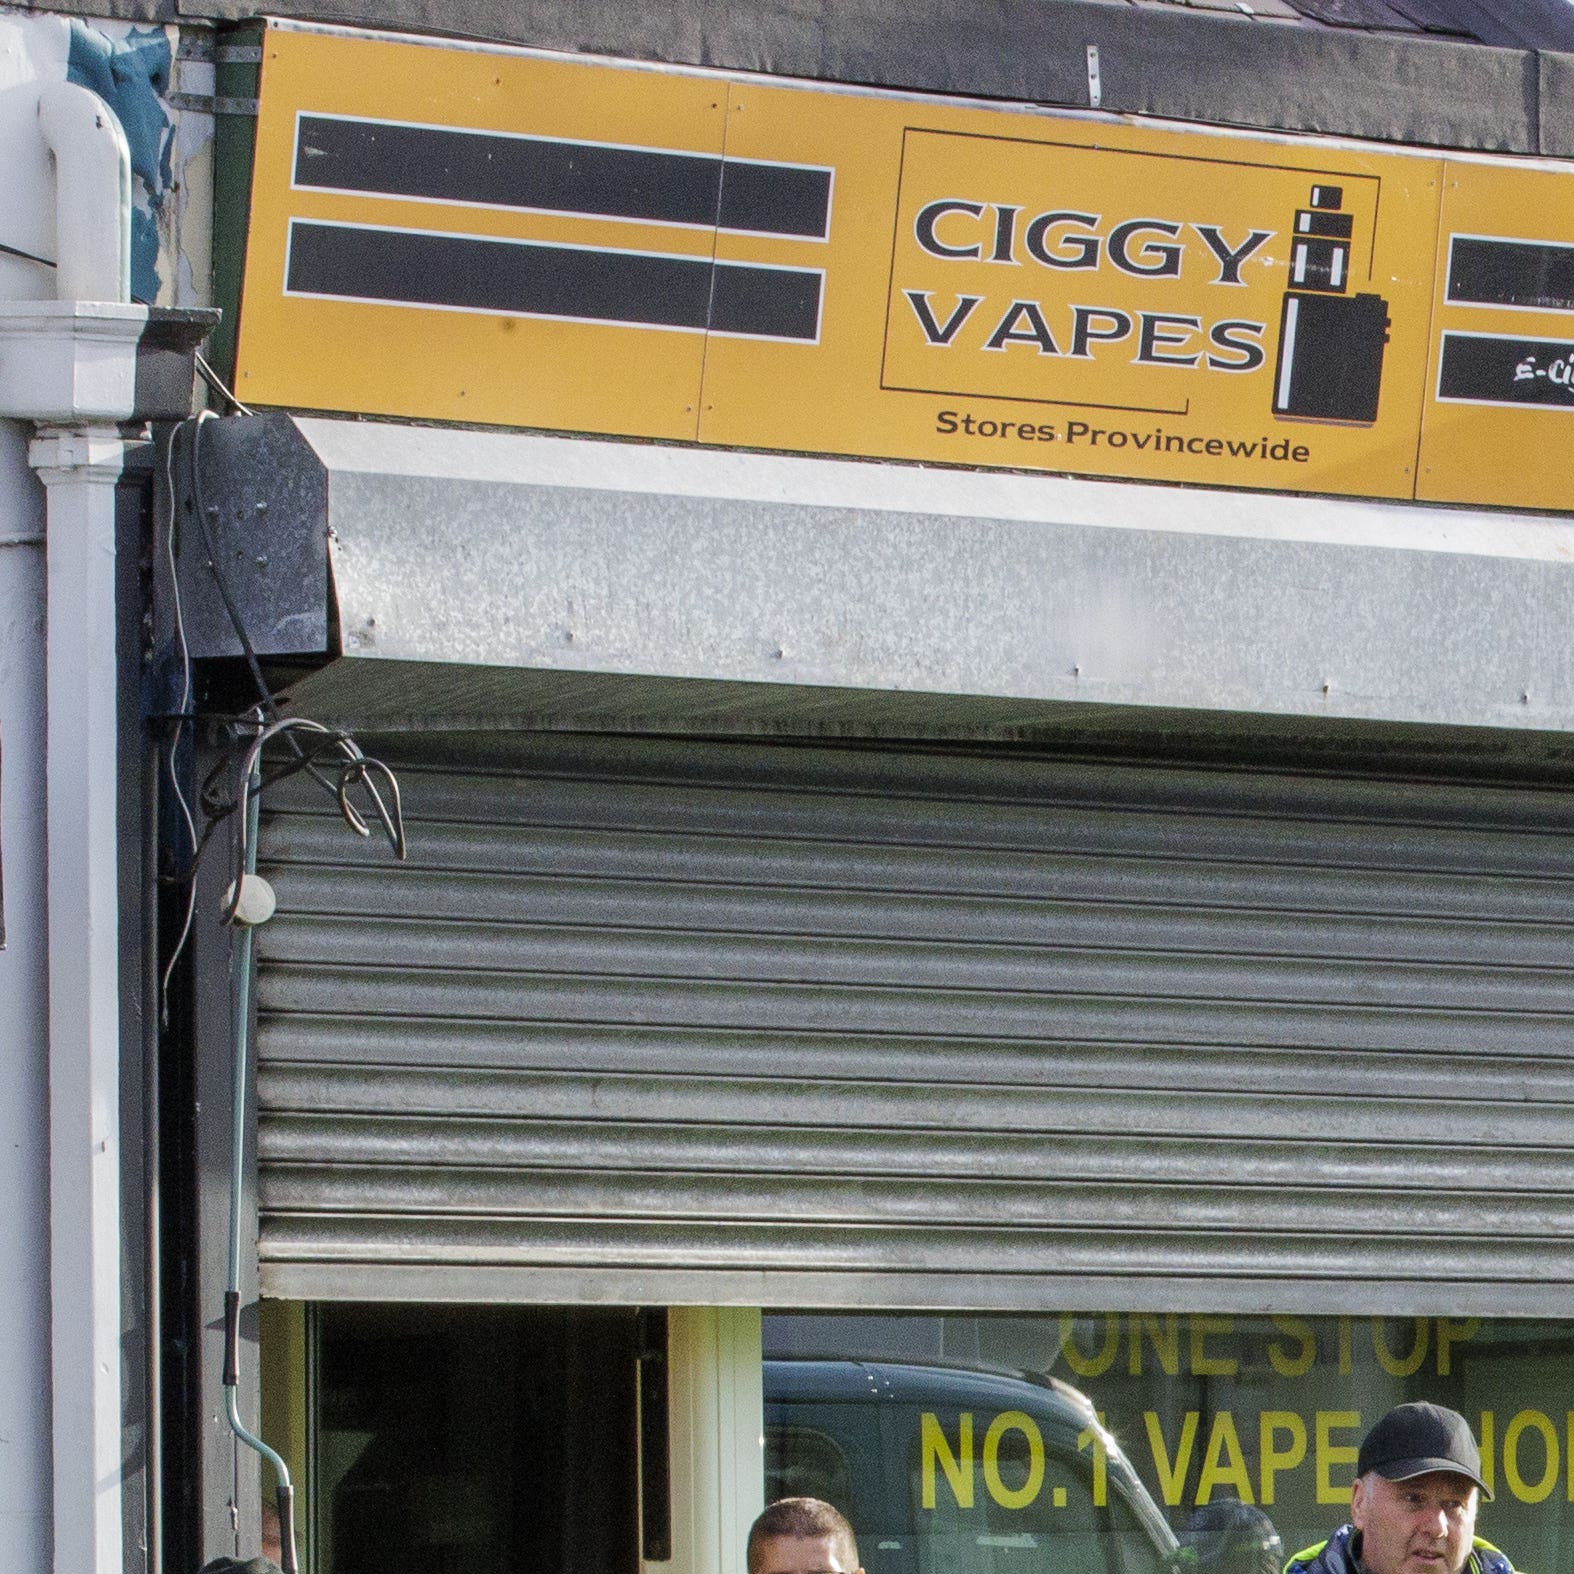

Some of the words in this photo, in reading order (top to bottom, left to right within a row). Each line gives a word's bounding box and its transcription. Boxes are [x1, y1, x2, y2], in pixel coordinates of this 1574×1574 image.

[914, 198, 1278, 287] CIGGY
[901, 288, 1268, 374] VAPES
[936, 411, 1055, 442] Stores
[1066, 421, 1310, 463] Provincewide
[1144, 1411, 1362, 1505] VAPE
